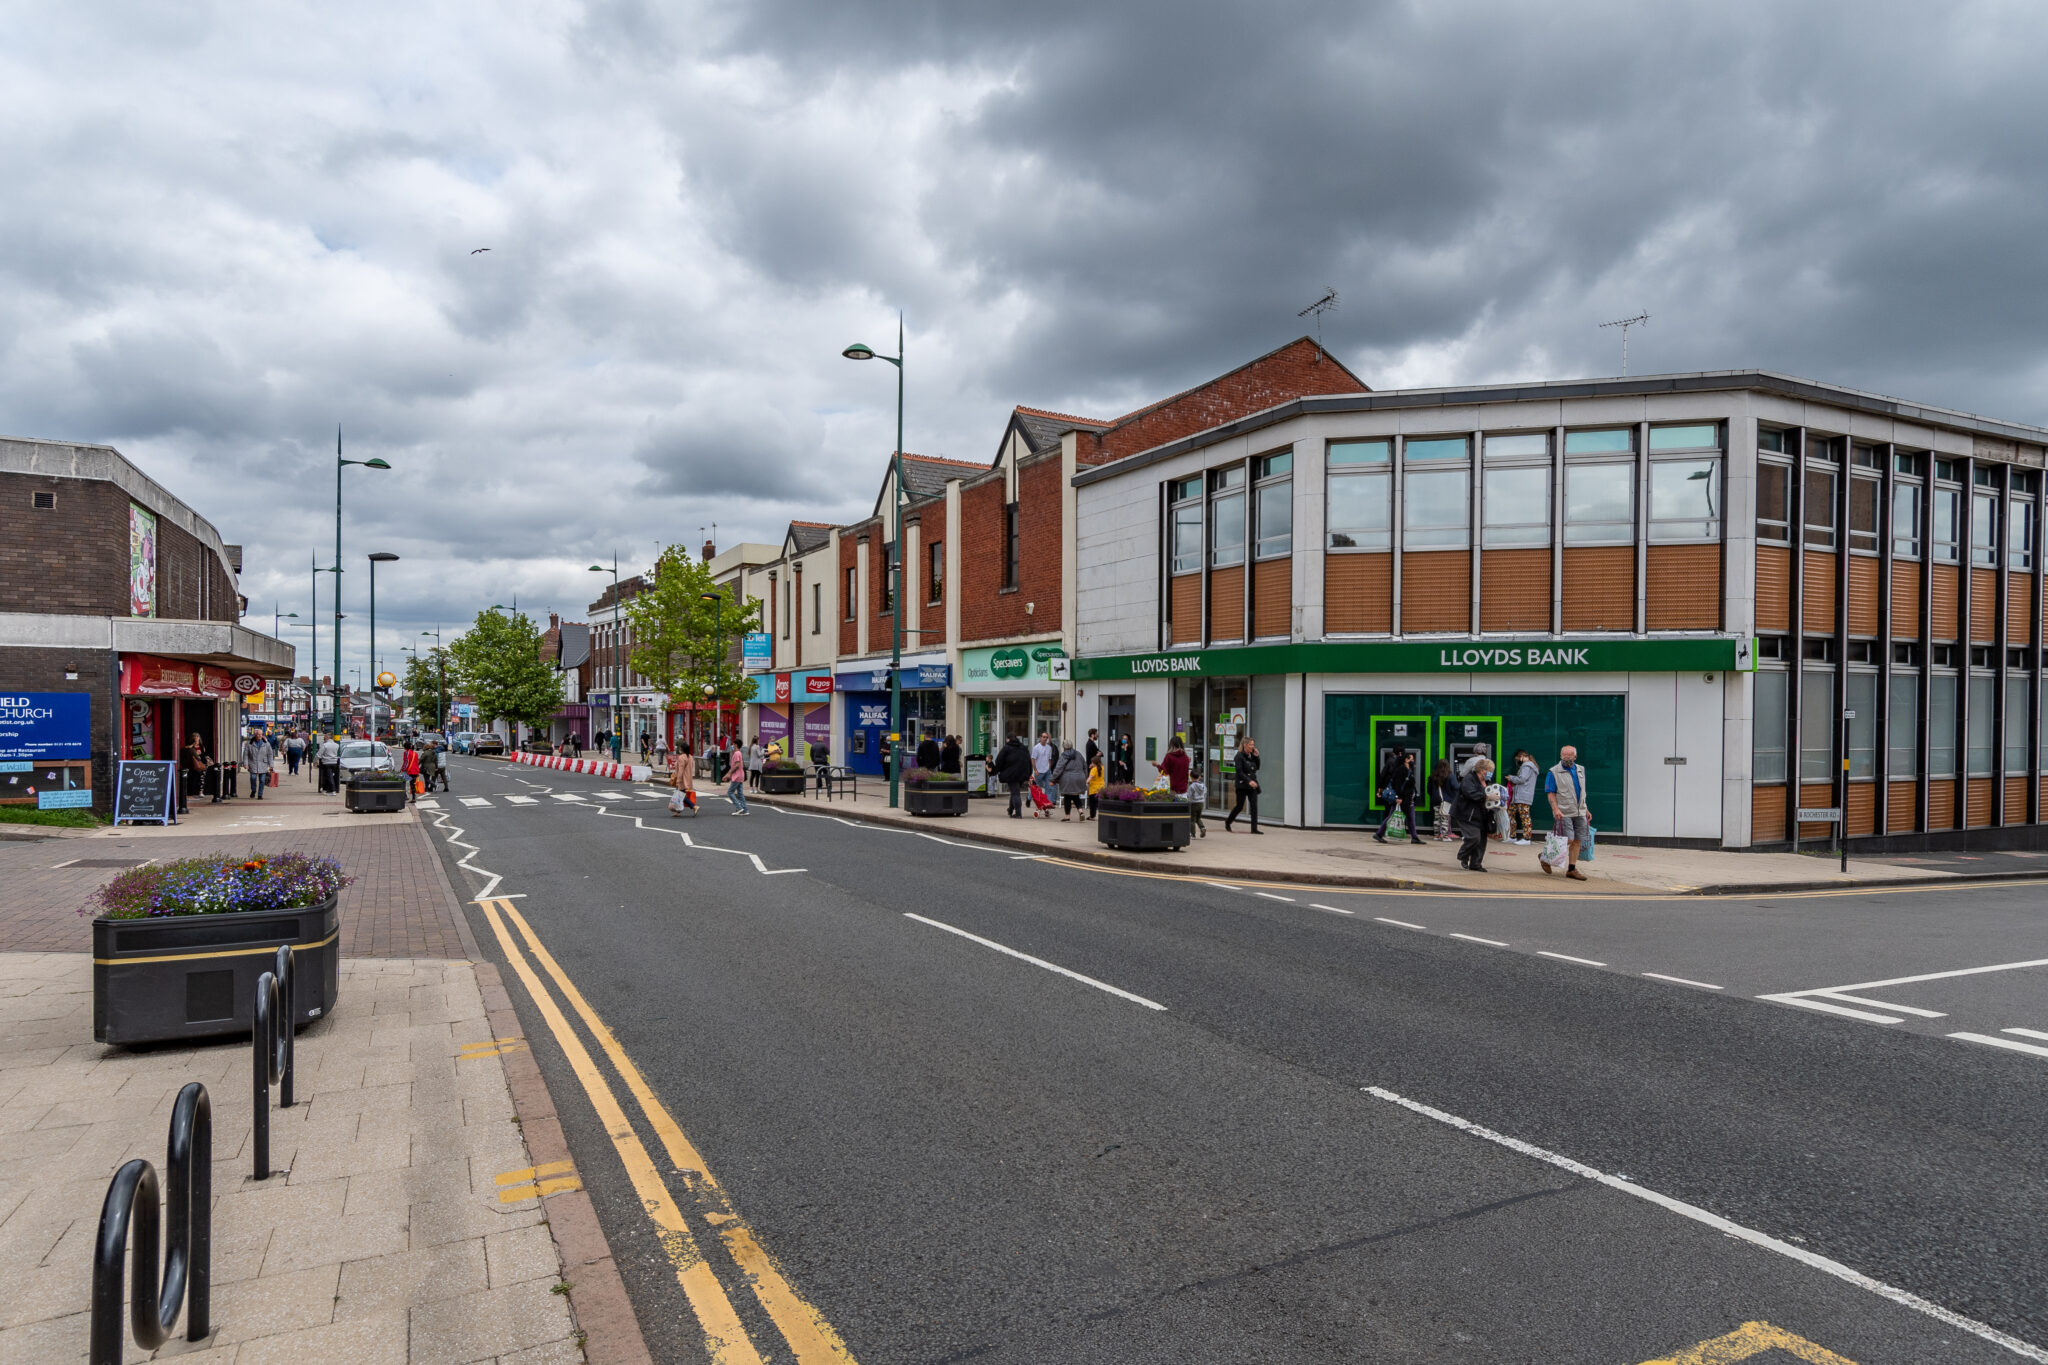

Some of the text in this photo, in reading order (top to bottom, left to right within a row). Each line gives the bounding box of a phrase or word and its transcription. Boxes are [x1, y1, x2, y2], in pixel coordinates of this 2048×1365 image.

[1440, 648, 1589, 666] LLOYDS BANK
[993, 658, 1023, 670] Specsavers
[1131, 657, 1201, 673] LLOYDS BANK
[968, 668, 989, 678] Opticians
[776, 680, 789, 694] Argos
[808, 679, 831, 688] Argos
[134, 768, 156, 778] Open
